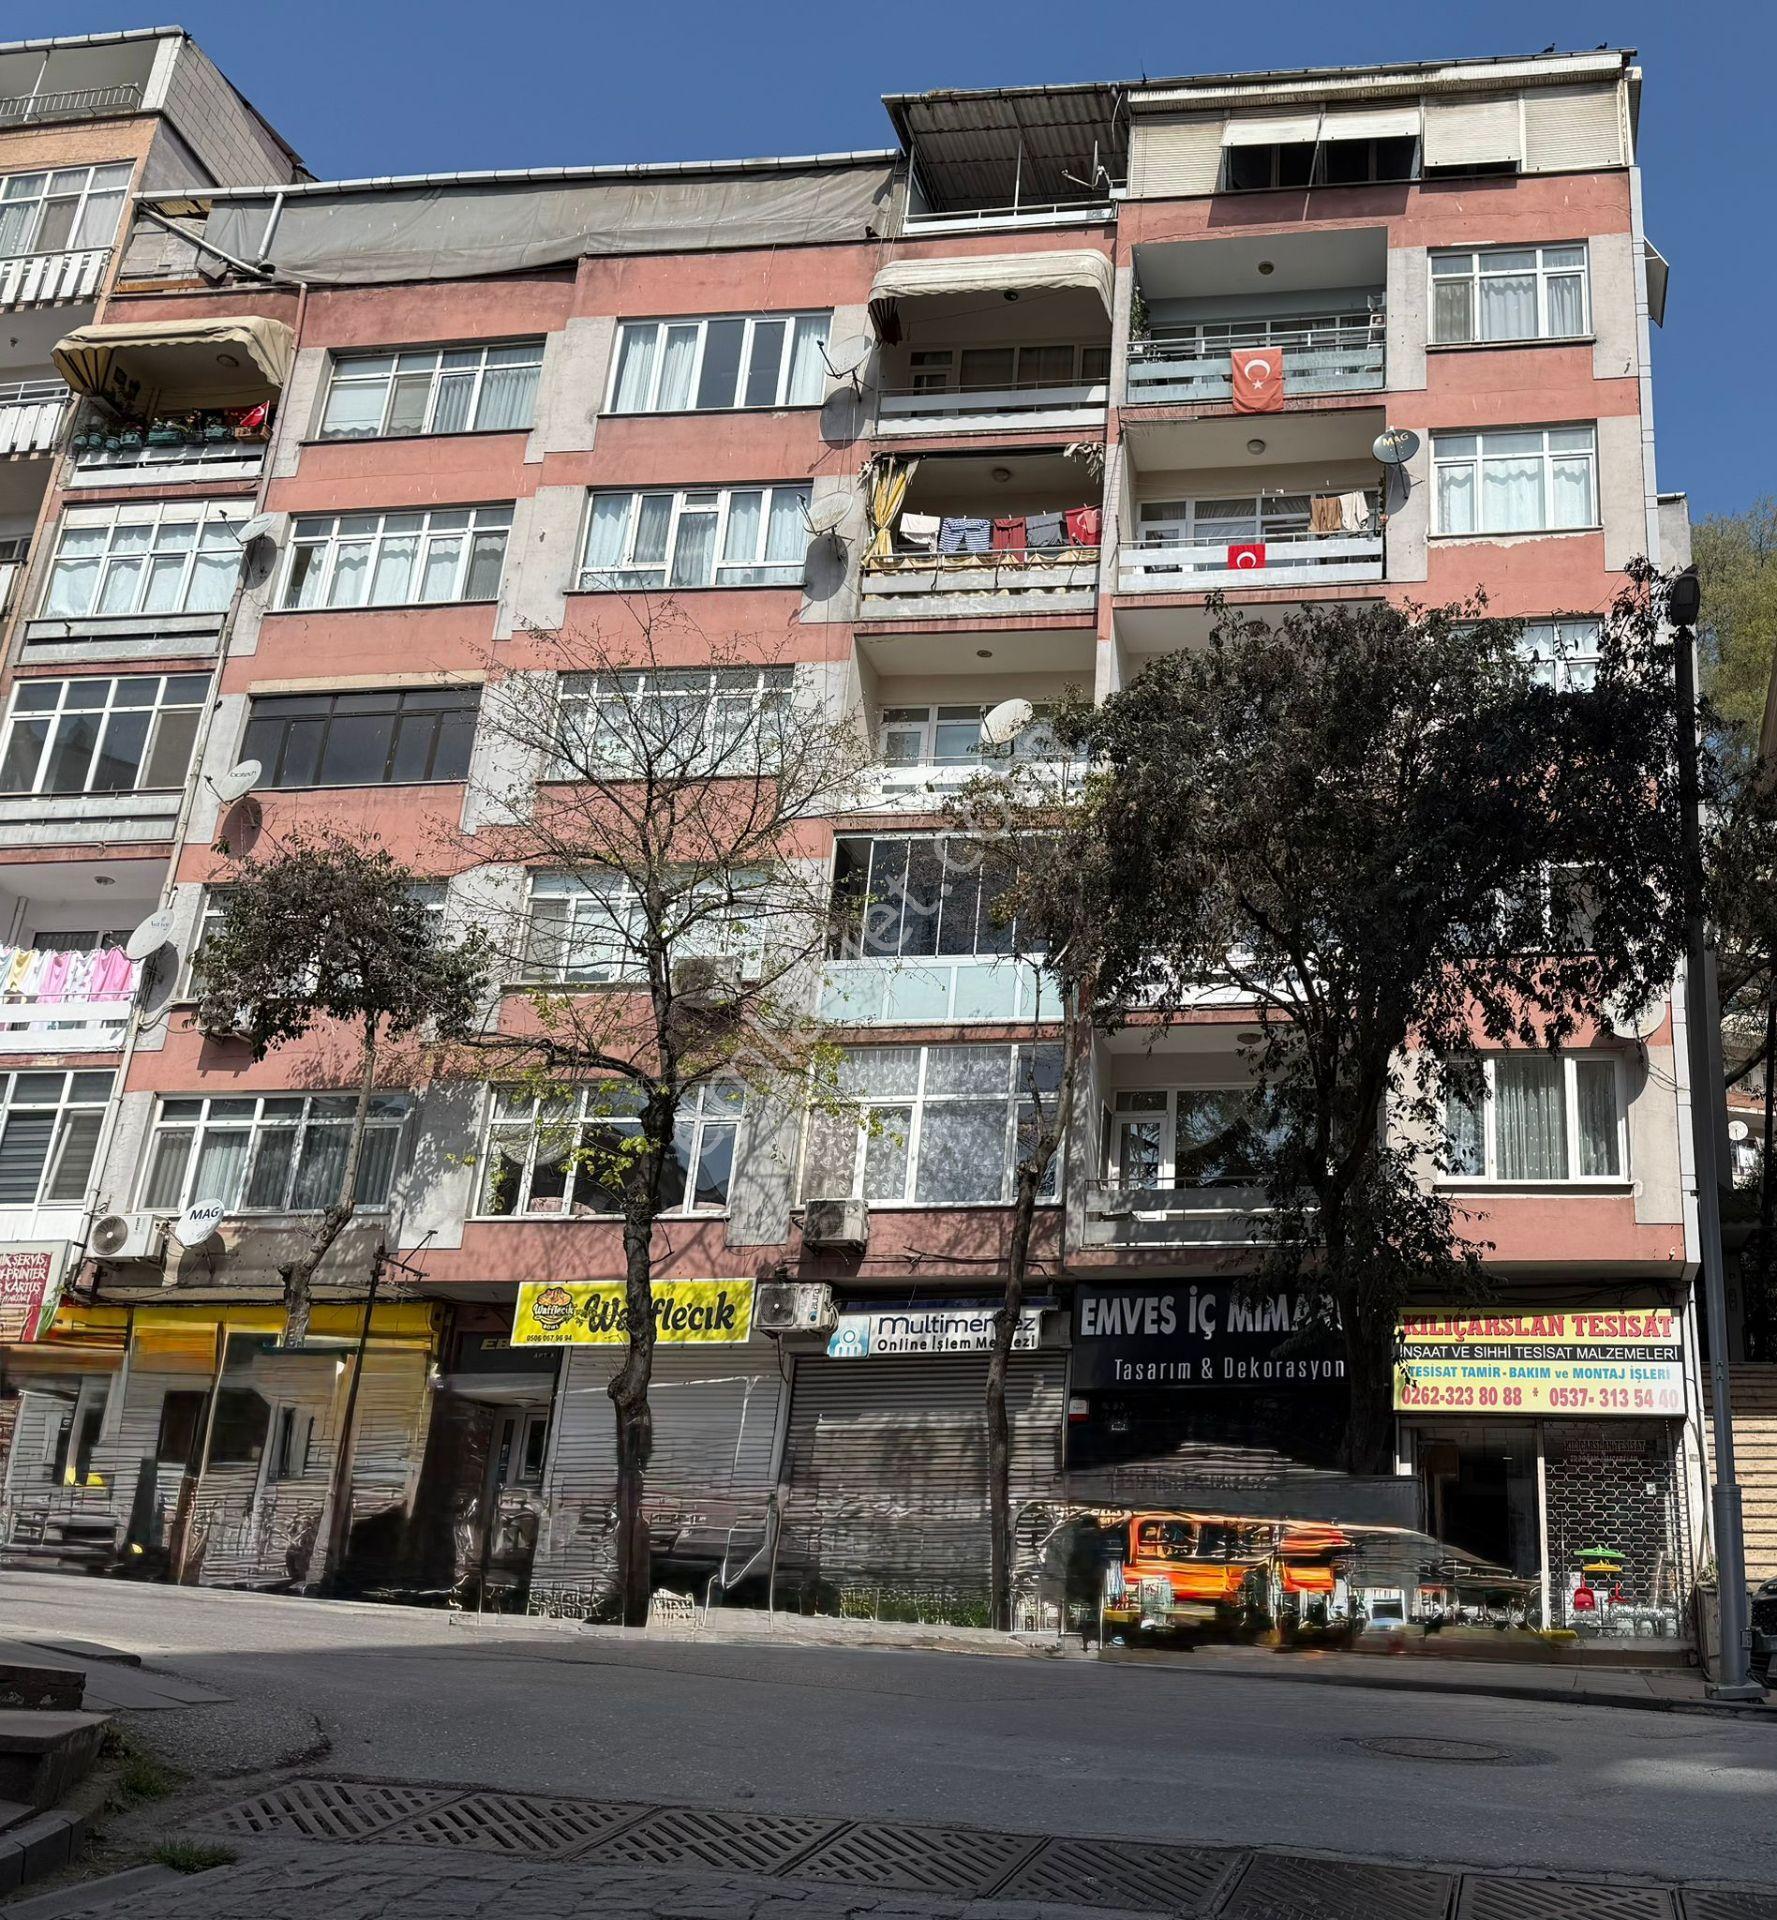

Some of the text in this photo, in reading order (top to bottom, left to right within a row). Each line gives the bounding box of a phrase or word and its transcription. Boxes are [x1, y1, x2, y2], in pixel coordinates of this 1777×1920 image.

[1383, 432, 1408, 446] MAG
[190, 1207, 219, 1220] MAG
[584, 1292, 735, 1332] Wafle'cık
[1081, 1295, 1176, 1336] EMVES
[1188, 1285, 1216, 1340] İÇ
[1402, 1310, 1674, 1342] KILIÇARSLAN TESİSAT
[877, 1335, 1035, 1352] Online İşlem Meezi
[1399, 1345, 1678, 1360] İNŞAAT VE SIHHİ TESİSAT MALZEMELERİ
[1114, 1356, 1345, 1381] Tasarım & Dekorasyon
[1409, 1363, 1457, 1378] TESİSAT
[1555, 1369, 1568, 1379] ve
[1572, 1367, 1625, 1380] MONTAJ
[1630, 1365, 1670, 1383] İŞLERİ
[1402, 1387, 1522, 1406] 0262-323 80 88
[1599, 1388, 1629, 1407] 313
[1634, 1388, 1654, 1408] 54
[1658, 1389, 1679, 1408] 40
